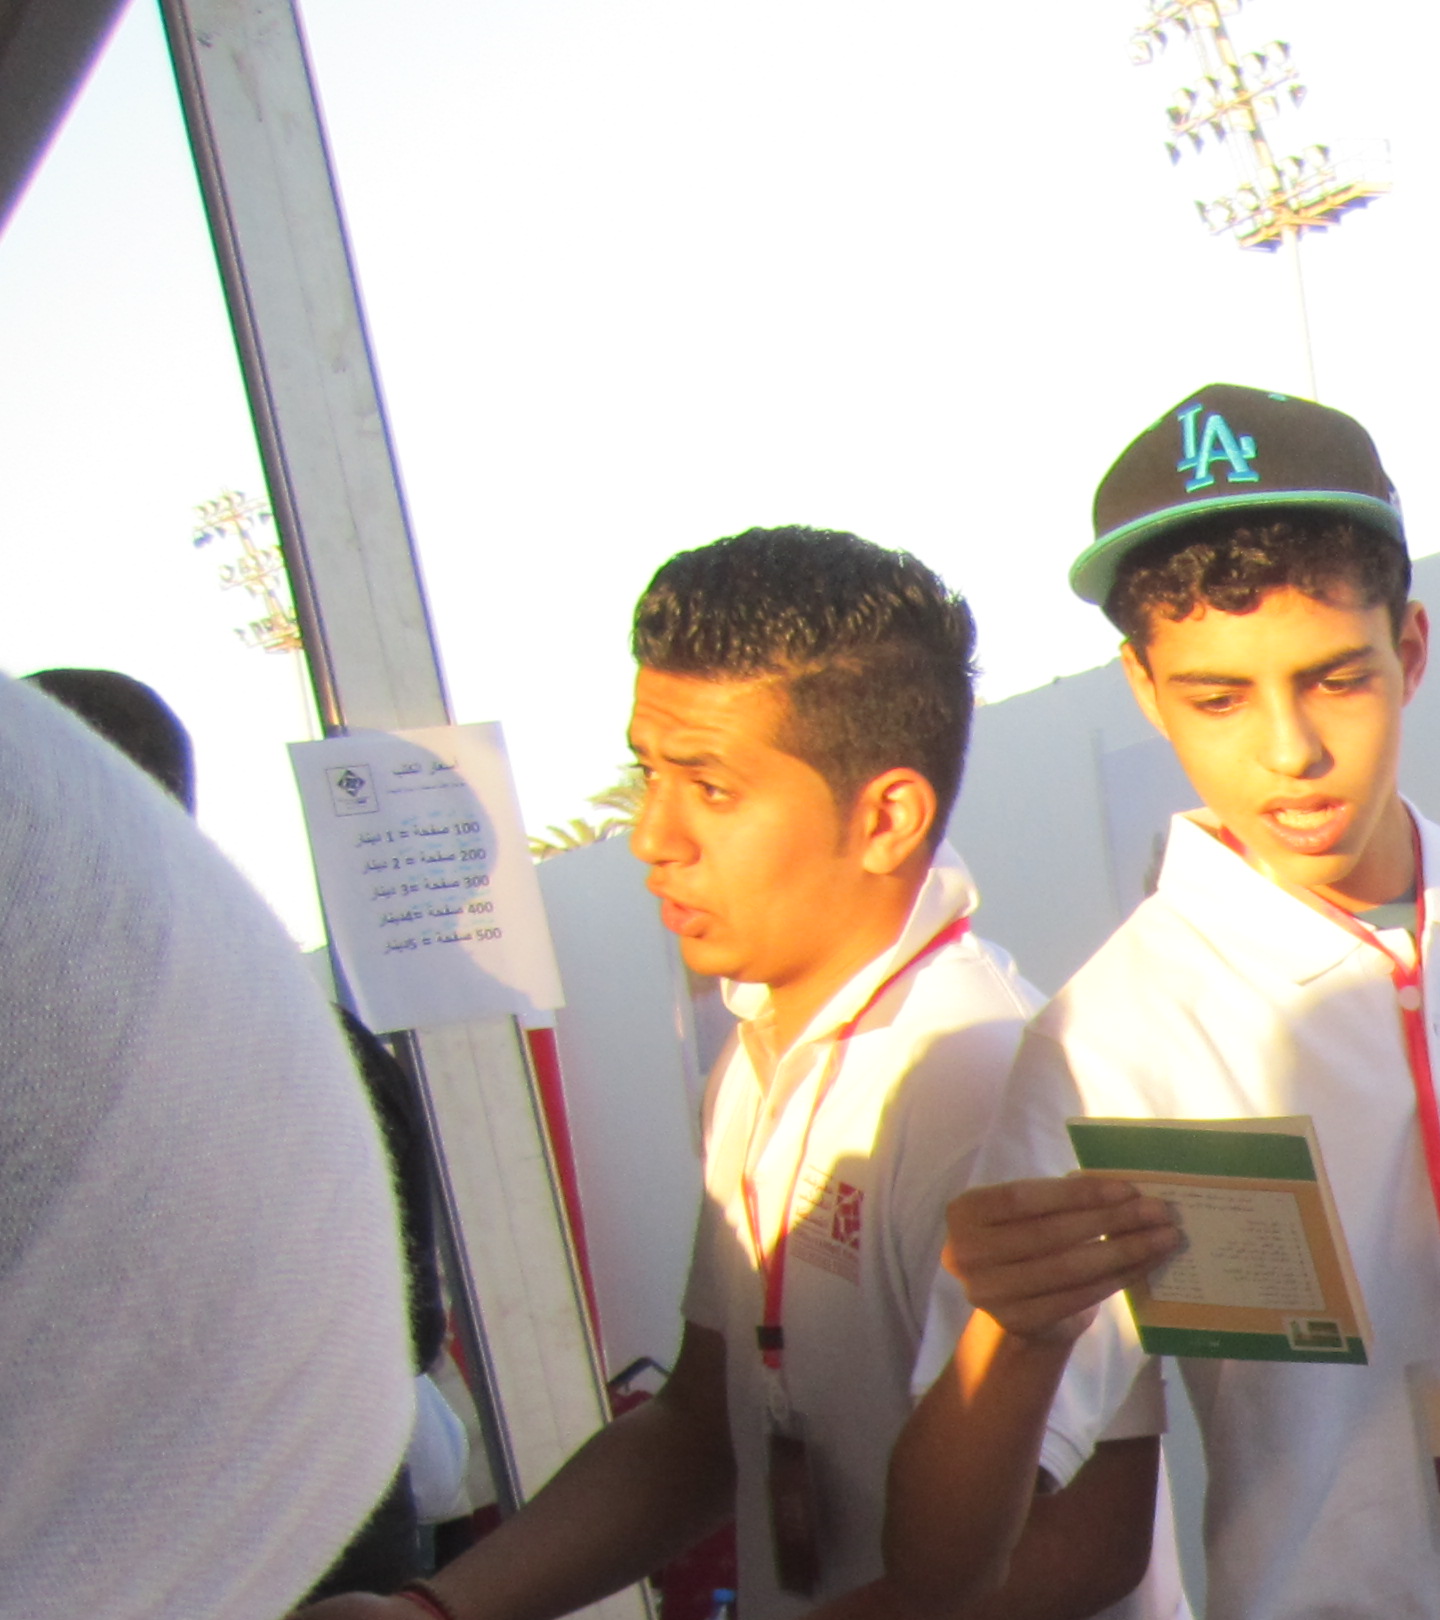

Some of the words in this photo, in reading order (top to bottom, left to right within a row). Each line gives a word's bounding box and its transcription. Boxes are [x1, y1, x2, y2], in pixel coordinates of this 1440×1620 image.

[1177, 403, 1260, 493] LA
[454, 821, 481, 836] 100
[460, 848, 487, 863] 200
[463, 874, 490, 889] 300
[467, 901, 494, 915] 400
[476, 927, 503, 942] 500
